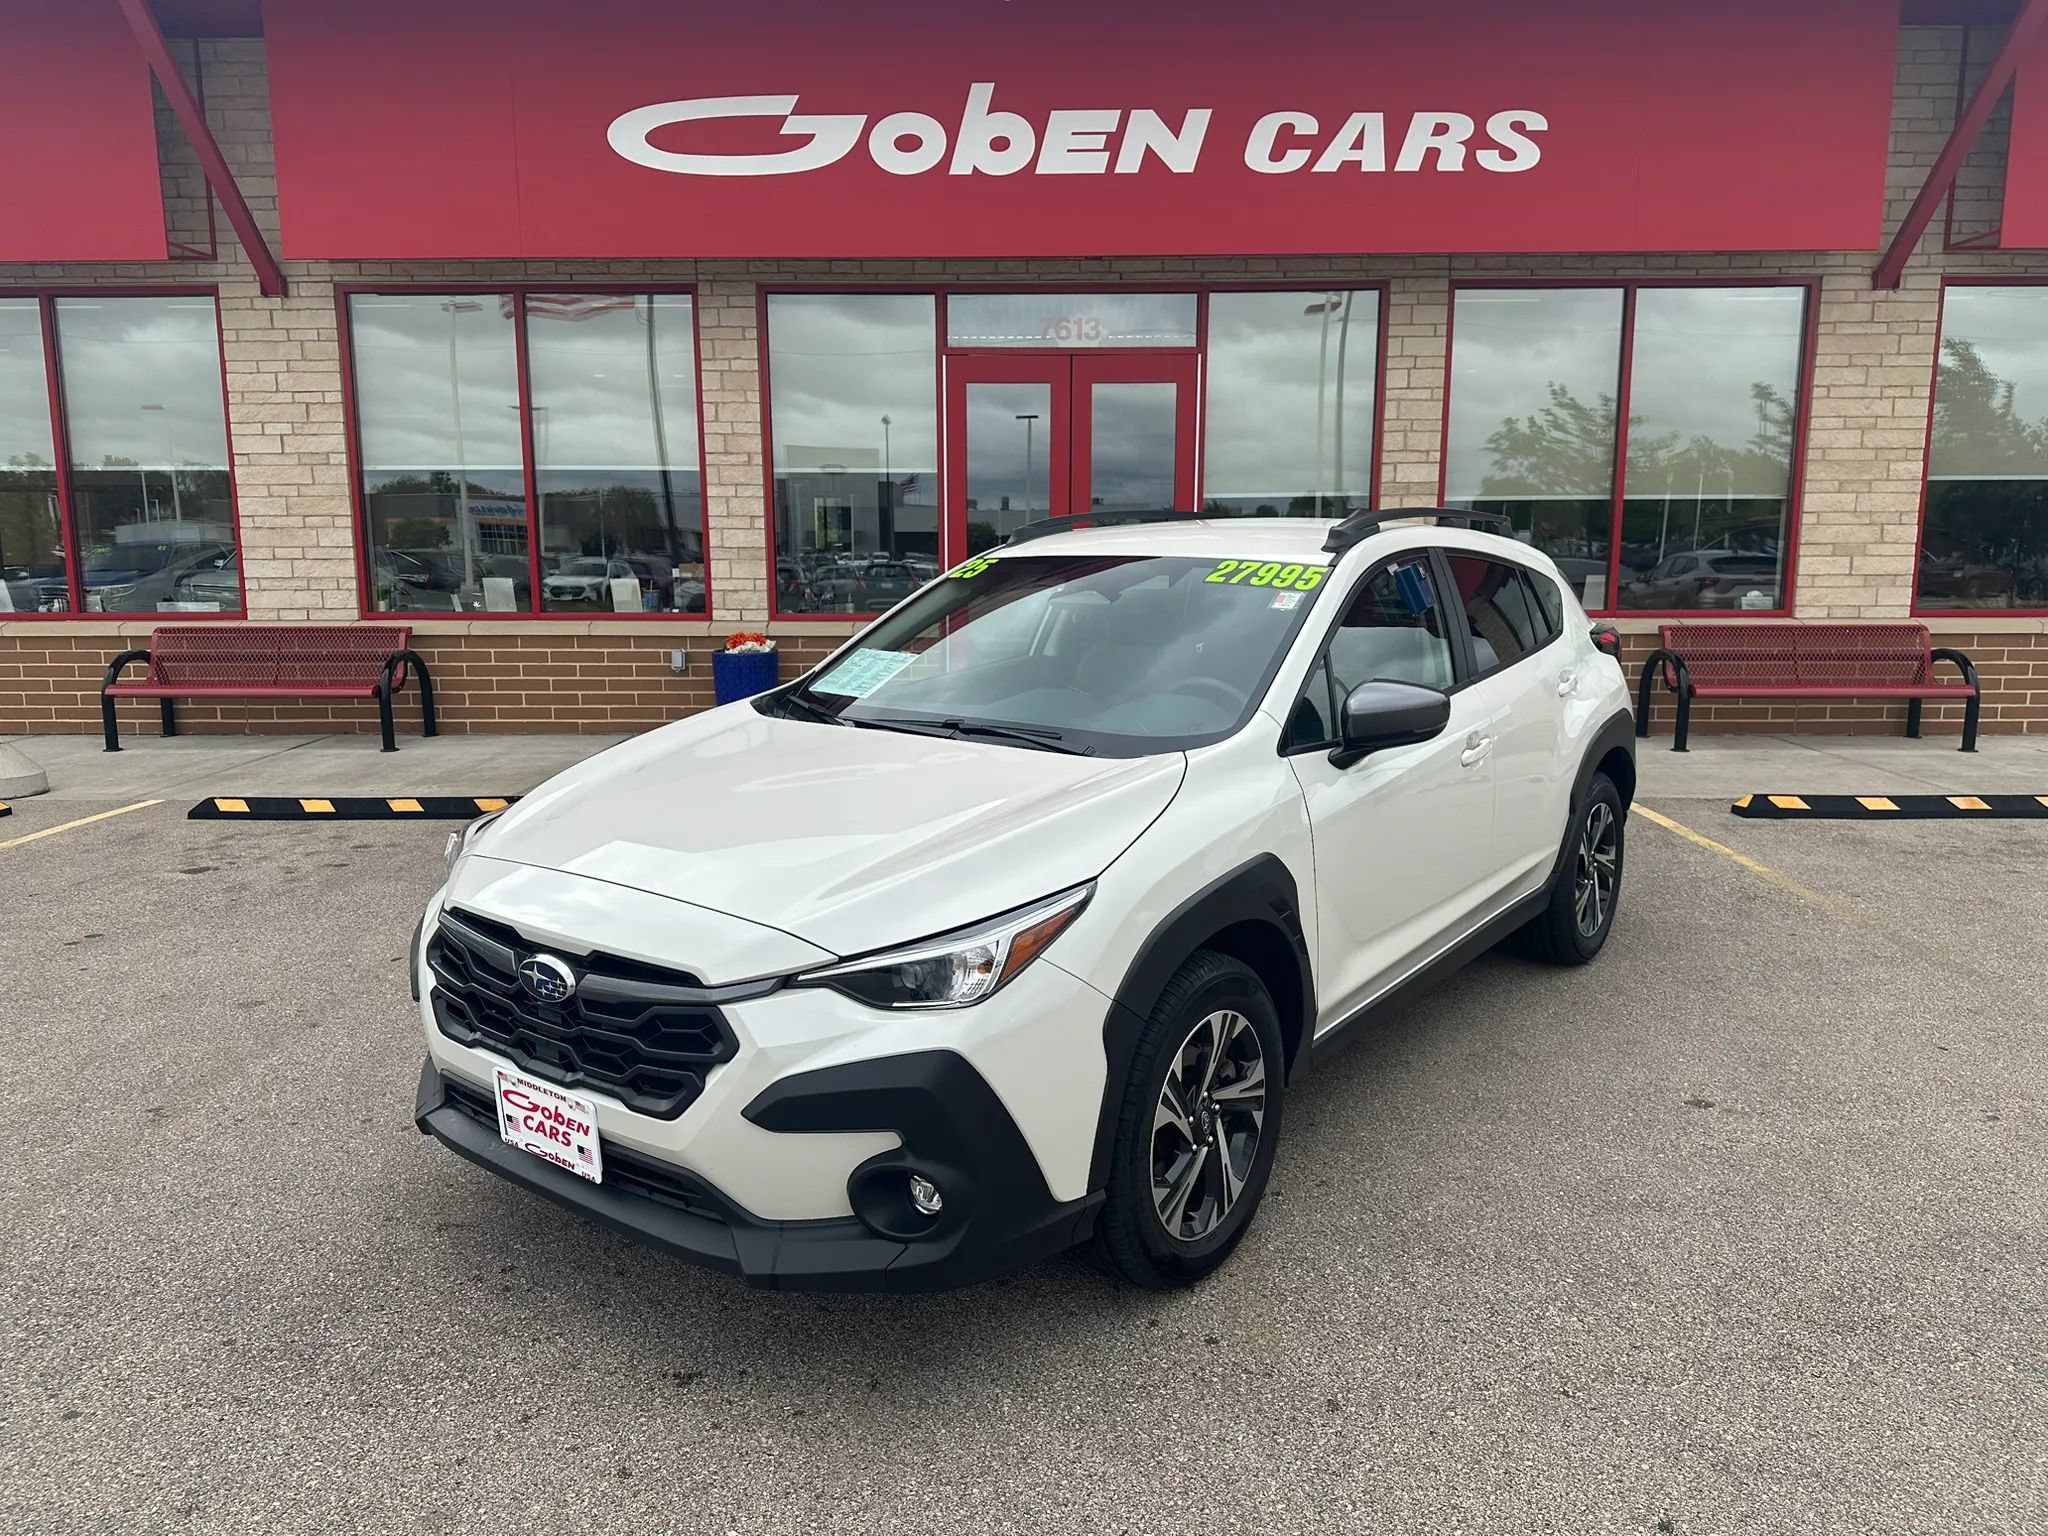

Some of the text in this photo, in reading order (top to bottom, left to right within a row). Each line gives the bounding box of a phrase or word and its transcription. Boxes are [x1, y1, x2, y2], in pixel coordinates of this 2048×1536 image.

[1243, 109, 1550, 174] CARS
[1040, 317, 1101, 342] 7613
[947, 558, 1000, 580] 25
[1203, 559, 1329, 591] 27995
[516, 1077, 567, 1103] MIDDLETON
[523, 1115, 573, 1148] CARS
[504, 1137, 519, 1148] USA
[581, 1170, 596, 1183] USA
